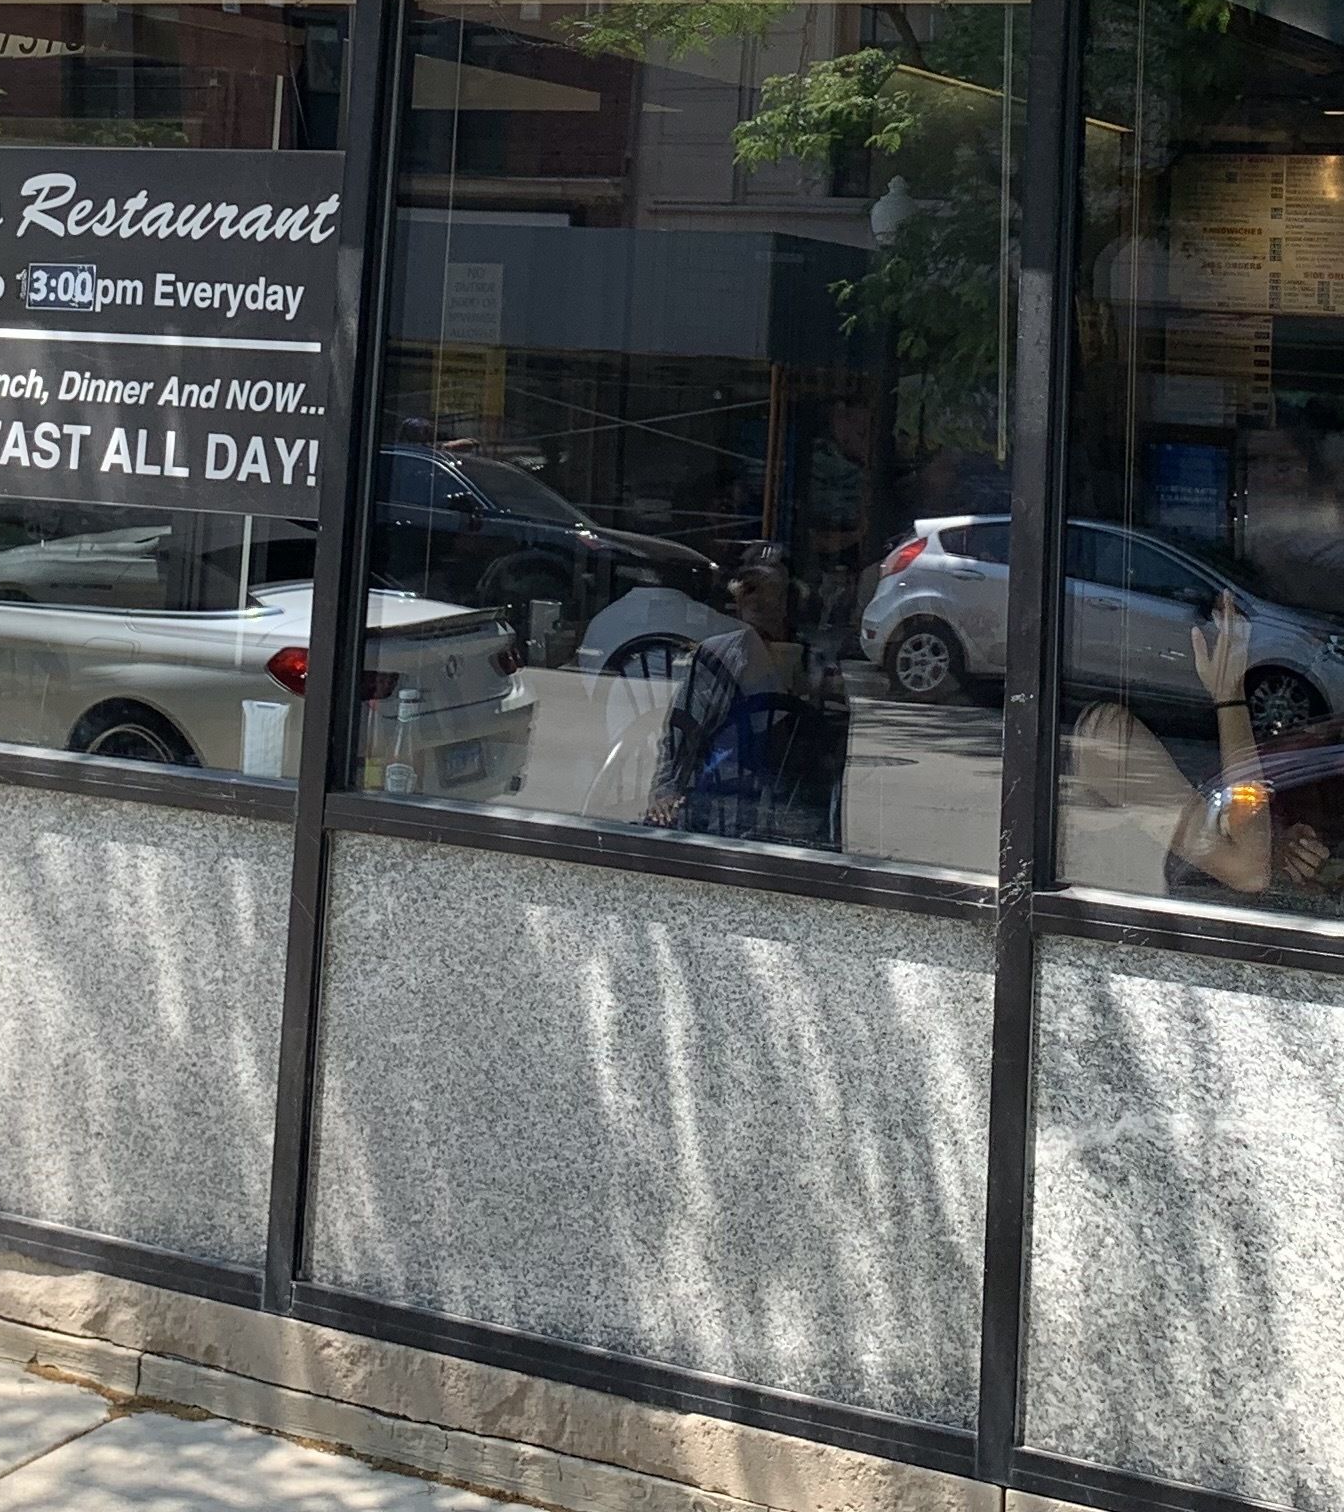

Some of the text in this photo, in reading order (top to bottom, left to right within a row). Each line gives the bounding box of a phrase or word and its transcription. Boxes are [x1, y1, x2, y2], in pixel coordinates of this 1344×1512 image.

[15, 171, 341, 244] Restaurant
[153, 272, 305, 321] Everyday
[58, 369, 154, 405] Dinner
[157, 375, 219, 410] And
[225, 379, 327, 416] NOW...
[100, 425, 190, 479] ALL
[204, 432, 321, 488] DAY!
